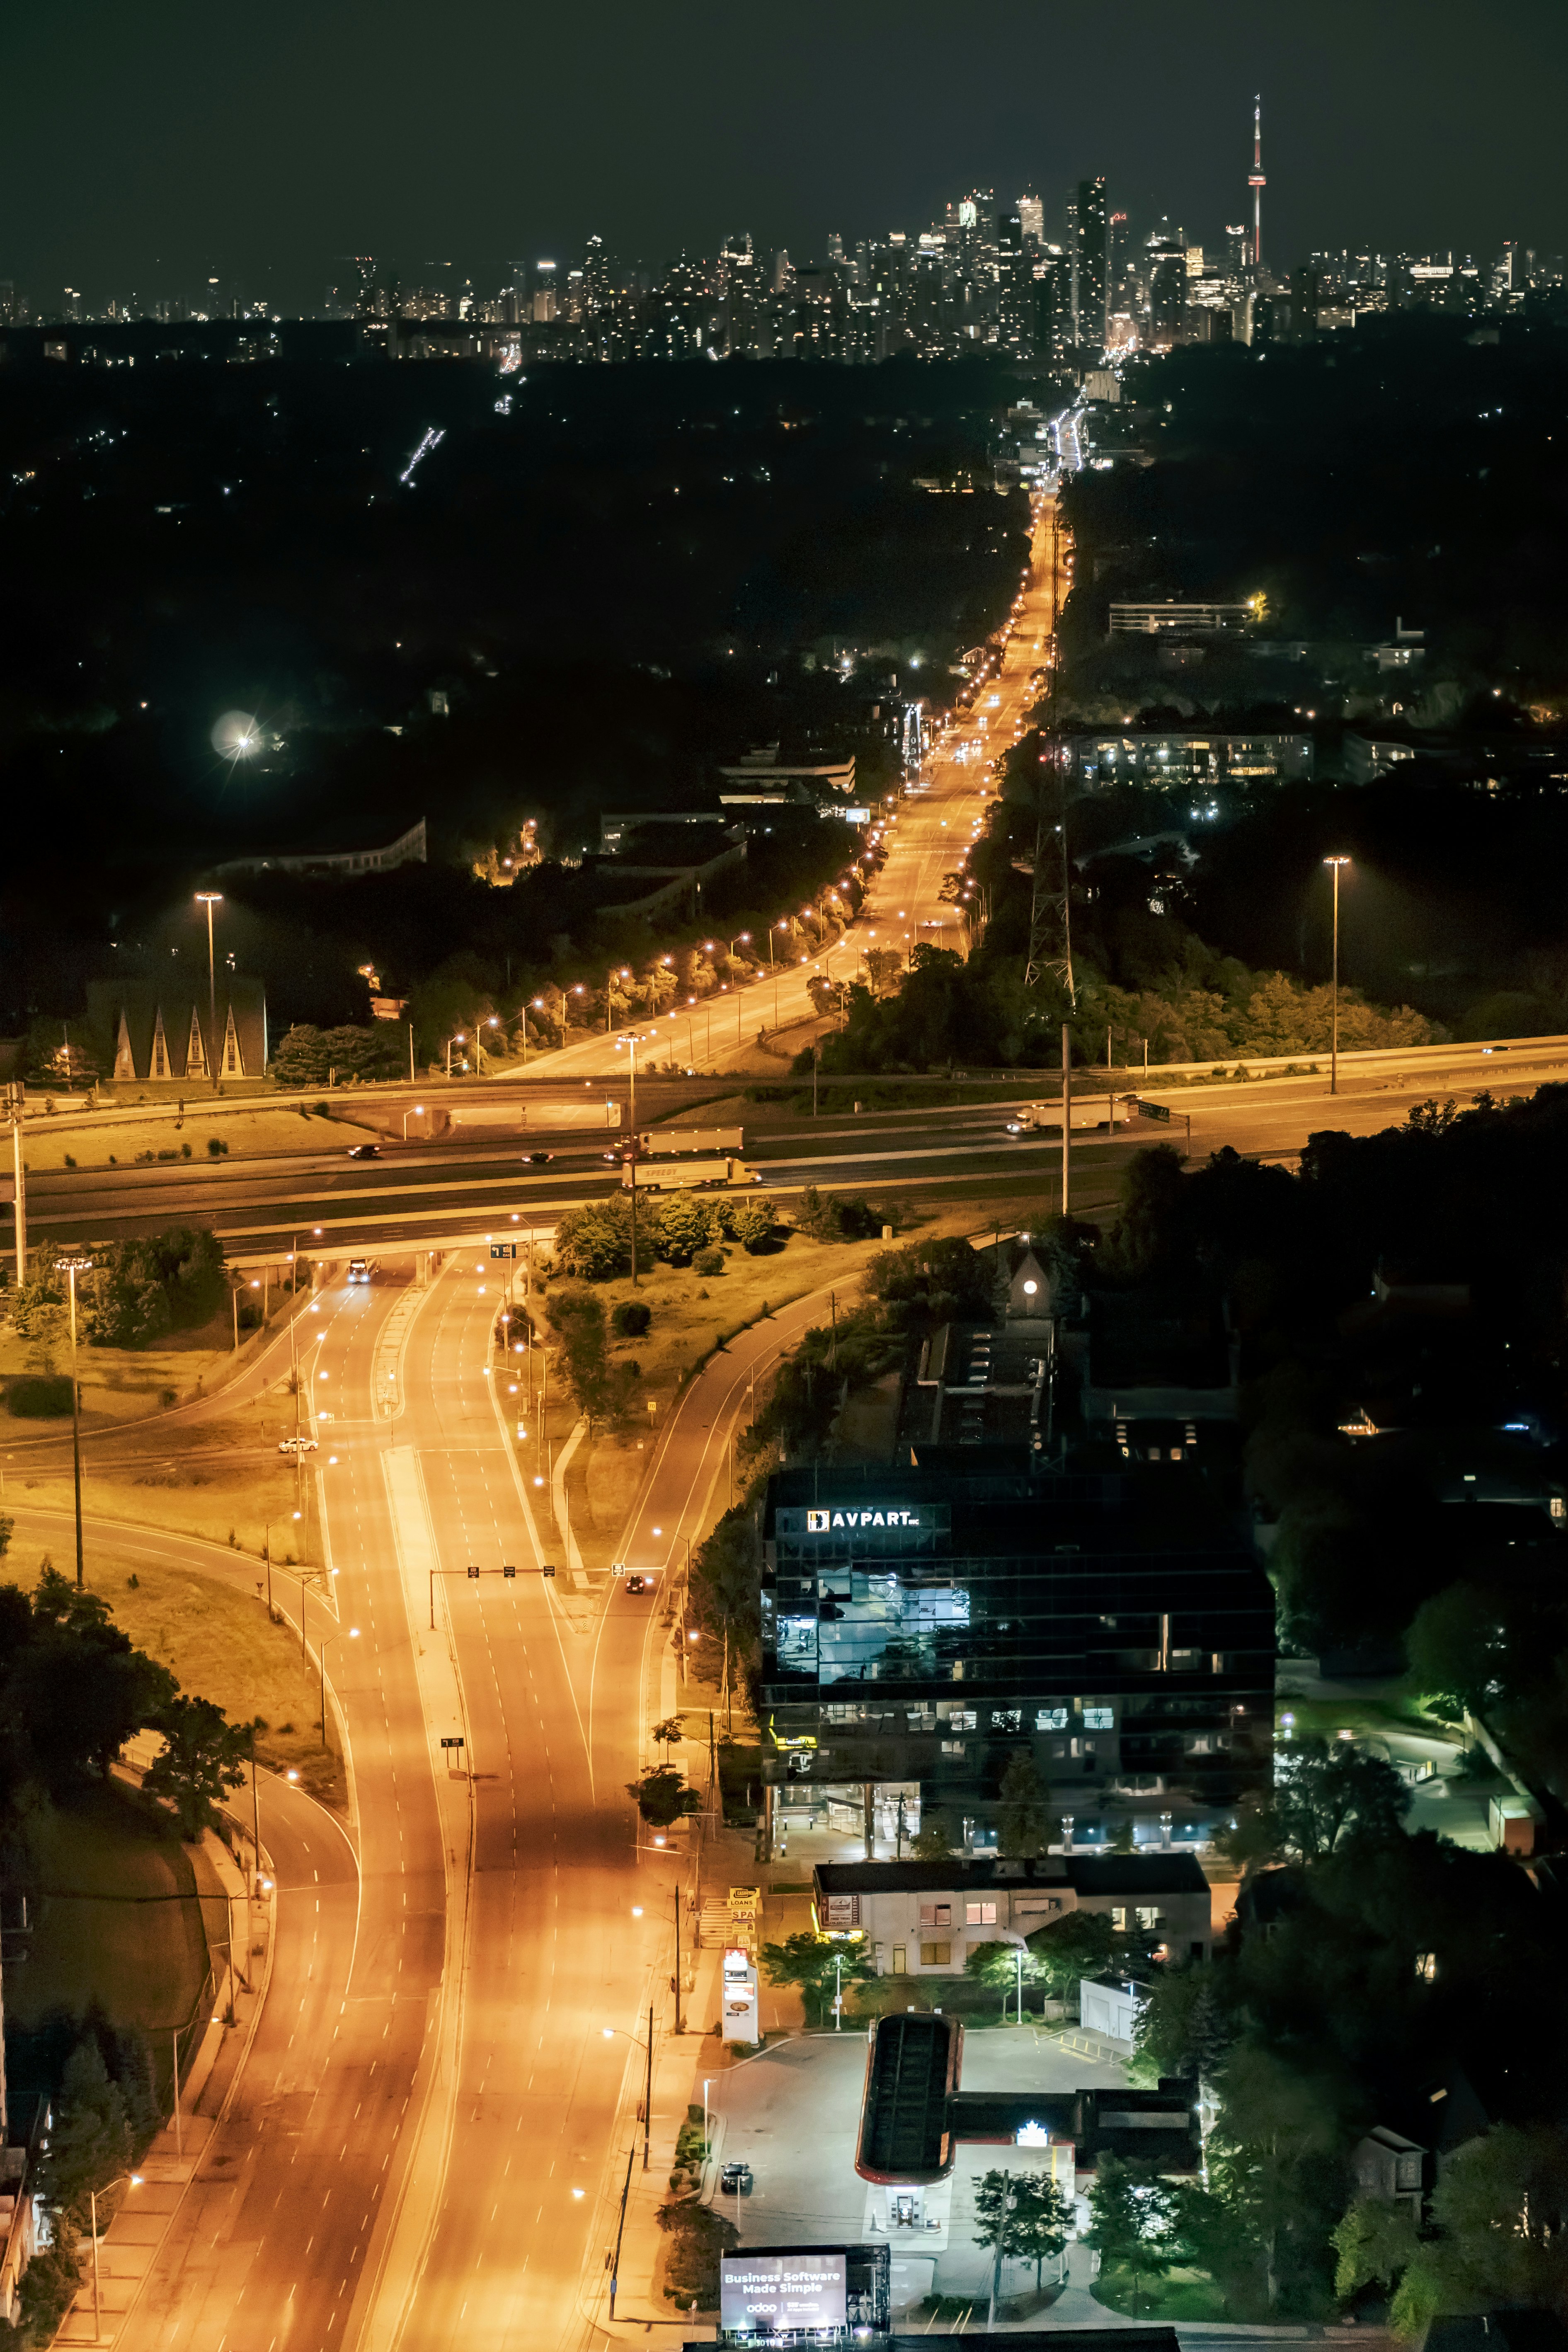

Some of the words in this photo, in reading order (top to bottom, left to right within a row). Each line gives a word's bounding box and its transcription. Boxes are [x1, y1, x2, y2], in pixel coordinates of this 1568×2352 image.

[645, 1168, 678, 1176] SPEEDY
[725, 2273, 780, 2283] Business
[783, 2272, 841, 2281] Software
[743, 2284, 777, 2294] Made
[780, 2282, 823, 2294] Simple
[746, 2302, 777, 2313] odoo
